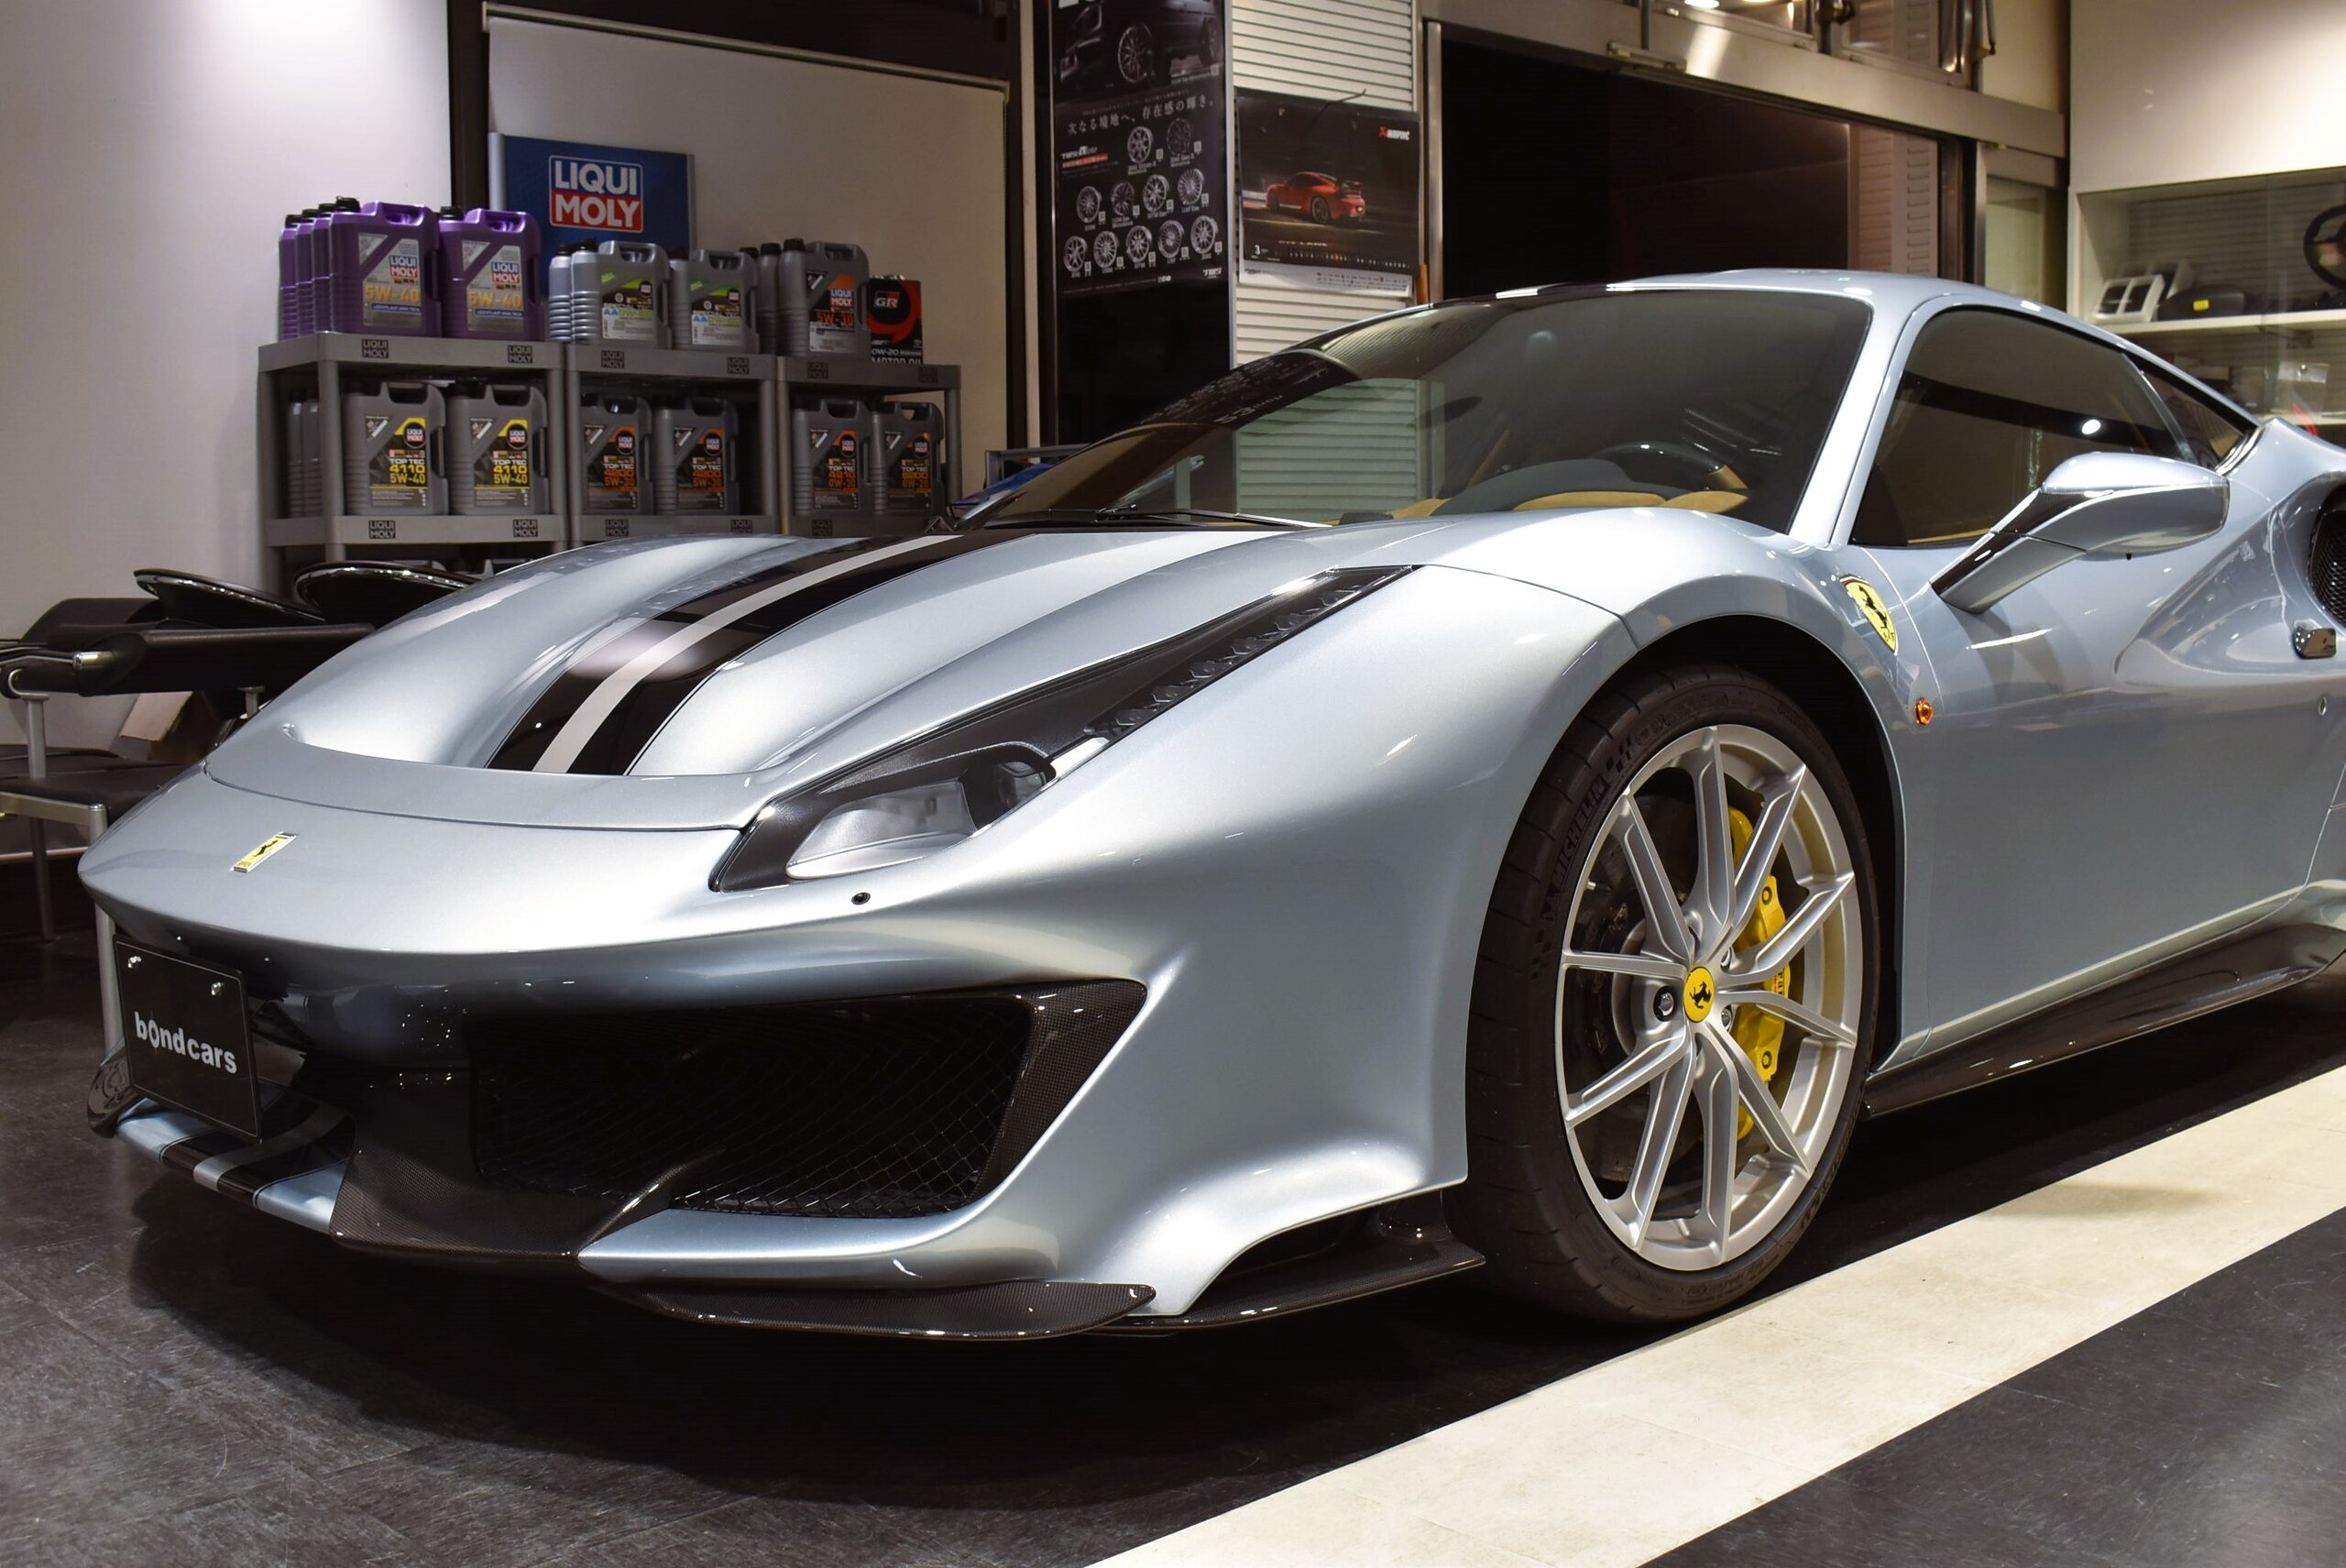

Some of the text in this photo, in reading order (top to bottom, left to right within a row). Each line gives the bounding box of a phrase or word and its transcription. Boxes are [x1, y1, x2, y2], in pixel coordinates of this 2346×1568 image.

[554, 160, 637, 195] LIQUI
[555, 193, 640, 228] MOLY
[389, 256, 417, 267] LIQUI
[390, 266, 418, 276] MOLY
[492, 262, 520, 273] LIQUI
[493, 273, 521, 282] MOLY
[366, 285, 420, 303] 5W-40
[831, 289, 852, 298] LIQUI
[469, 291, 522, 308] 5W-40
[831, 298, 853, 306] MOLY
[875, 298, 898, 308] GR
[817, 313, 854, 327] 5W-30
[363, 339, 388, 348] LIQUI
[364, 349, 389, 358] MOLY
[509, 345, 532, 355] LIQUI
[510, 355, 532, 364] MOLY
[389, 465, 426, 473] 4110
[493, 466, 528, 474] 4110
[389, 474, 426, 485] 5W-40
[494, 474, 528, 485] 5W-40
[370, 521, 395, 530] LIQUI
[514, 520, 537, 529] LIQUI
[607, 520, 628, 528] LIQUI
[370, 530, 396, 539] MOLY
[515, 528, 538, 537] MOLY
[607, 528, 629, 536] MOLY
[1551, 773, 1611, 891] MICHELIN
[135, 1011, 237, 1073] bond cars
